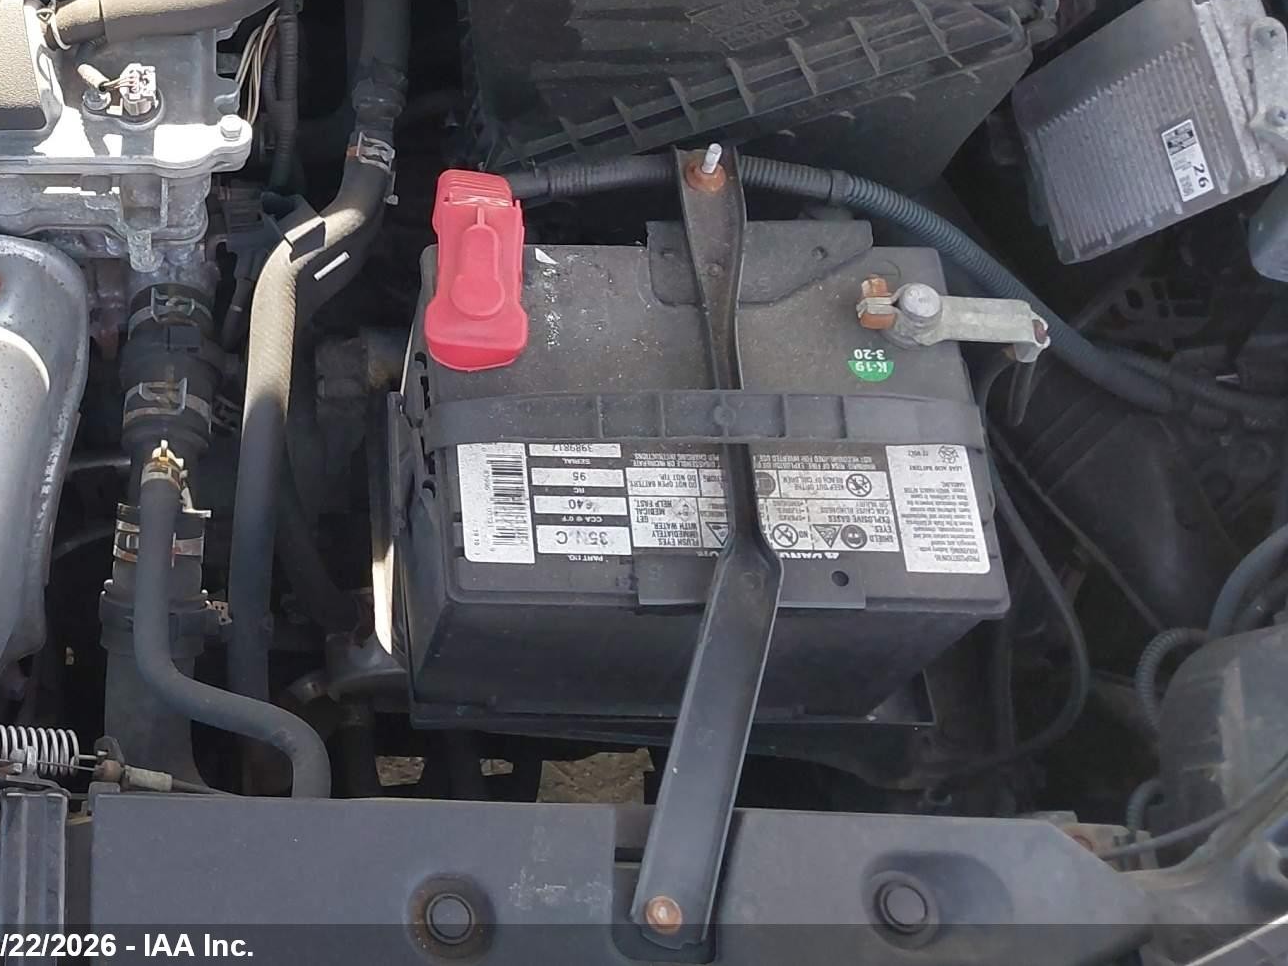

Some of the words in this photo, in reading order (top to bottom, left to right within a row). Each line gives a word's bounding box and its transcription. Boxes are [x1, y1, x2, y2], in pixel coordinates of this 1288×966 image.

[854, 349, 885, 360] 3-20
[855, 361, 888, 373] K-19
[573, 472, 586, 481] 95
[654, 500, 672, 508] HELP
[634, 508, 665, 516] MEDICAL
[678, 522, 697, 530] WITH
[651, 530, 698, 538] IMMEDIATELY
[677, 538, 699, 546] FLUSH
